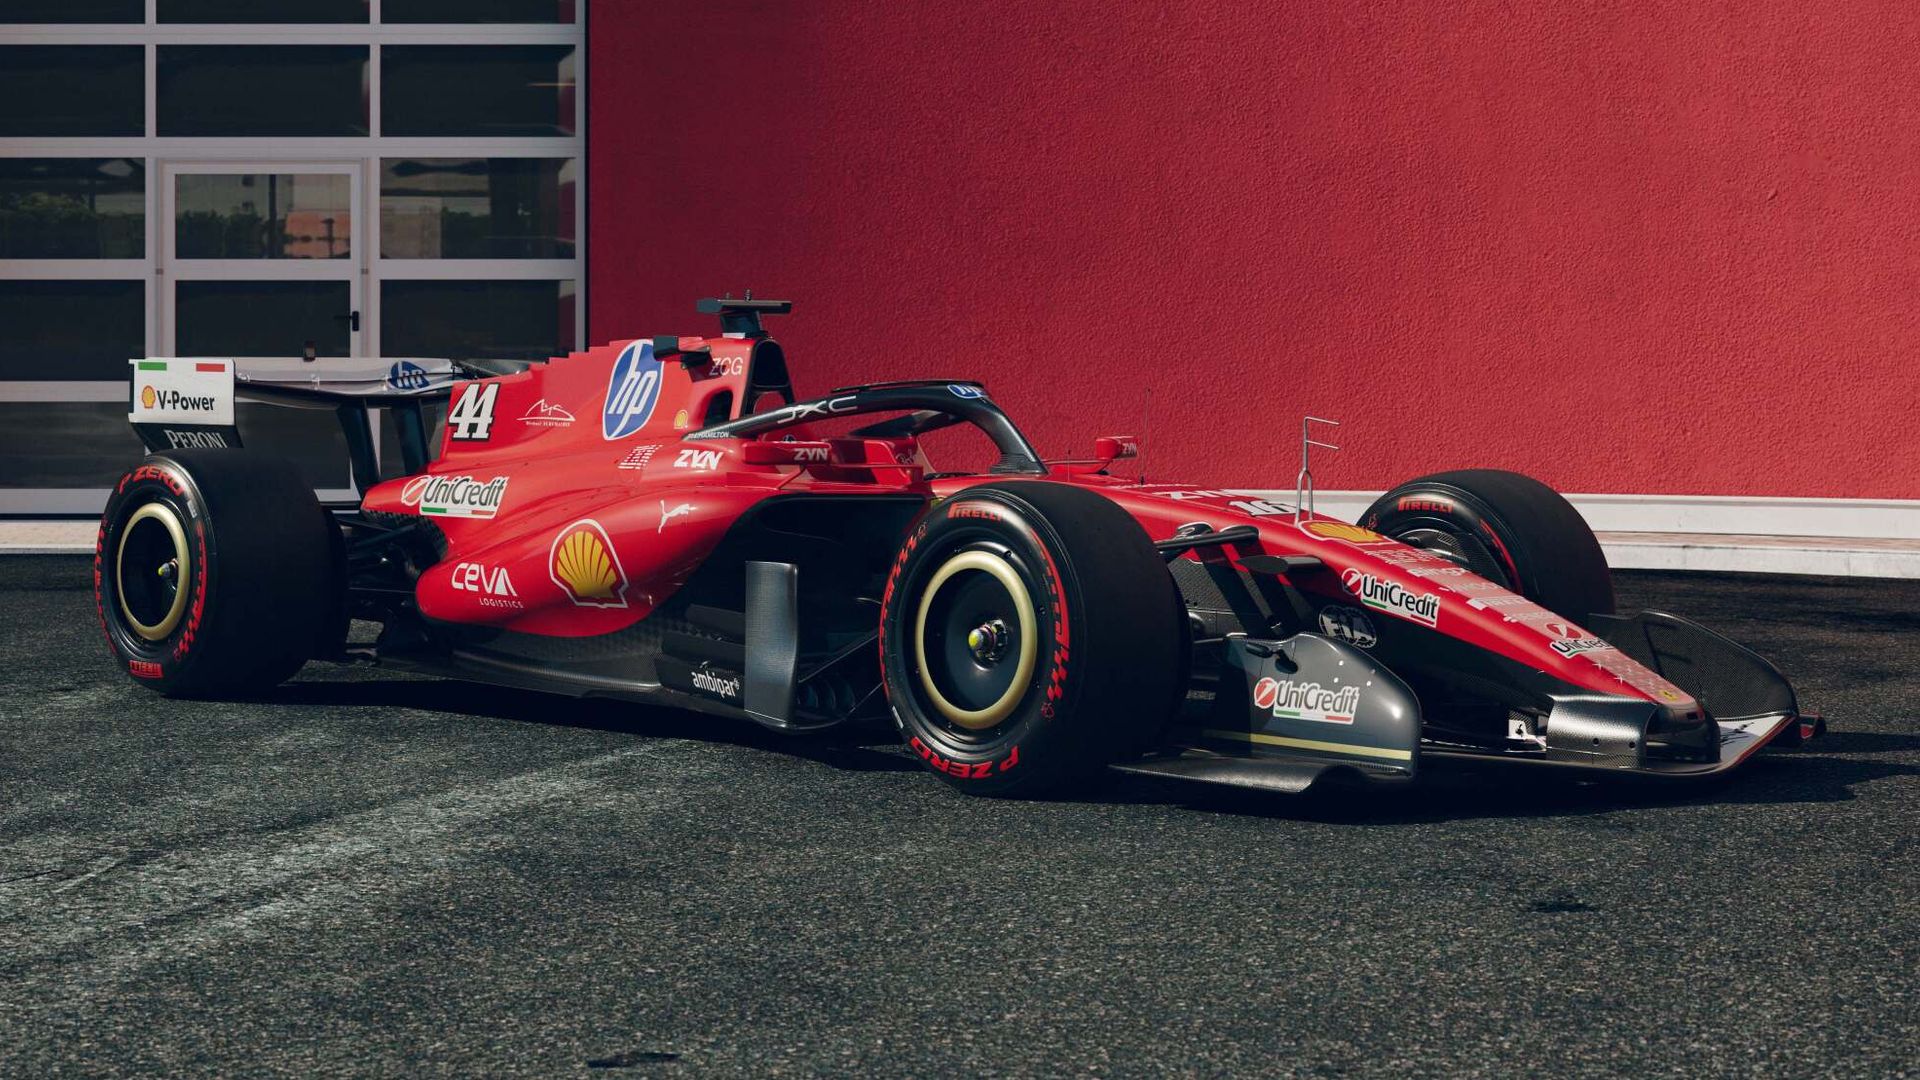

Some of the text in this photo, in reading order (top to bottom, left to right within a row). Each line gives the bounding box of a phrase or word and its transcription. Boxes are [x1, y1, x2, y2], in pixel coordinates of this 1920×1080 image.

[709, 356, 744, 376] ZCG
[156, 390, 215, 411] V-Power
[448, 383, 500, 441] 44
[163, 429, 228, 449] PERONI
[673, 449, 724, 470] ZYN
[793, 448, 829, 461] ZYN
[422, 476, 507, 508] UniCredit
[947, 502, 1004, 522] PIRELLI
[1397, 496, 1454, 513] PIRELLI
[478, 597, 524, 609] LOGISTICS
[1361, 575, 1439, 620] UniCredit
[690, 670, 736, 698] ambipar
[1275, 681, 1359, 715] UniCredit
[910, 736, 1020, 779] P ZERO
